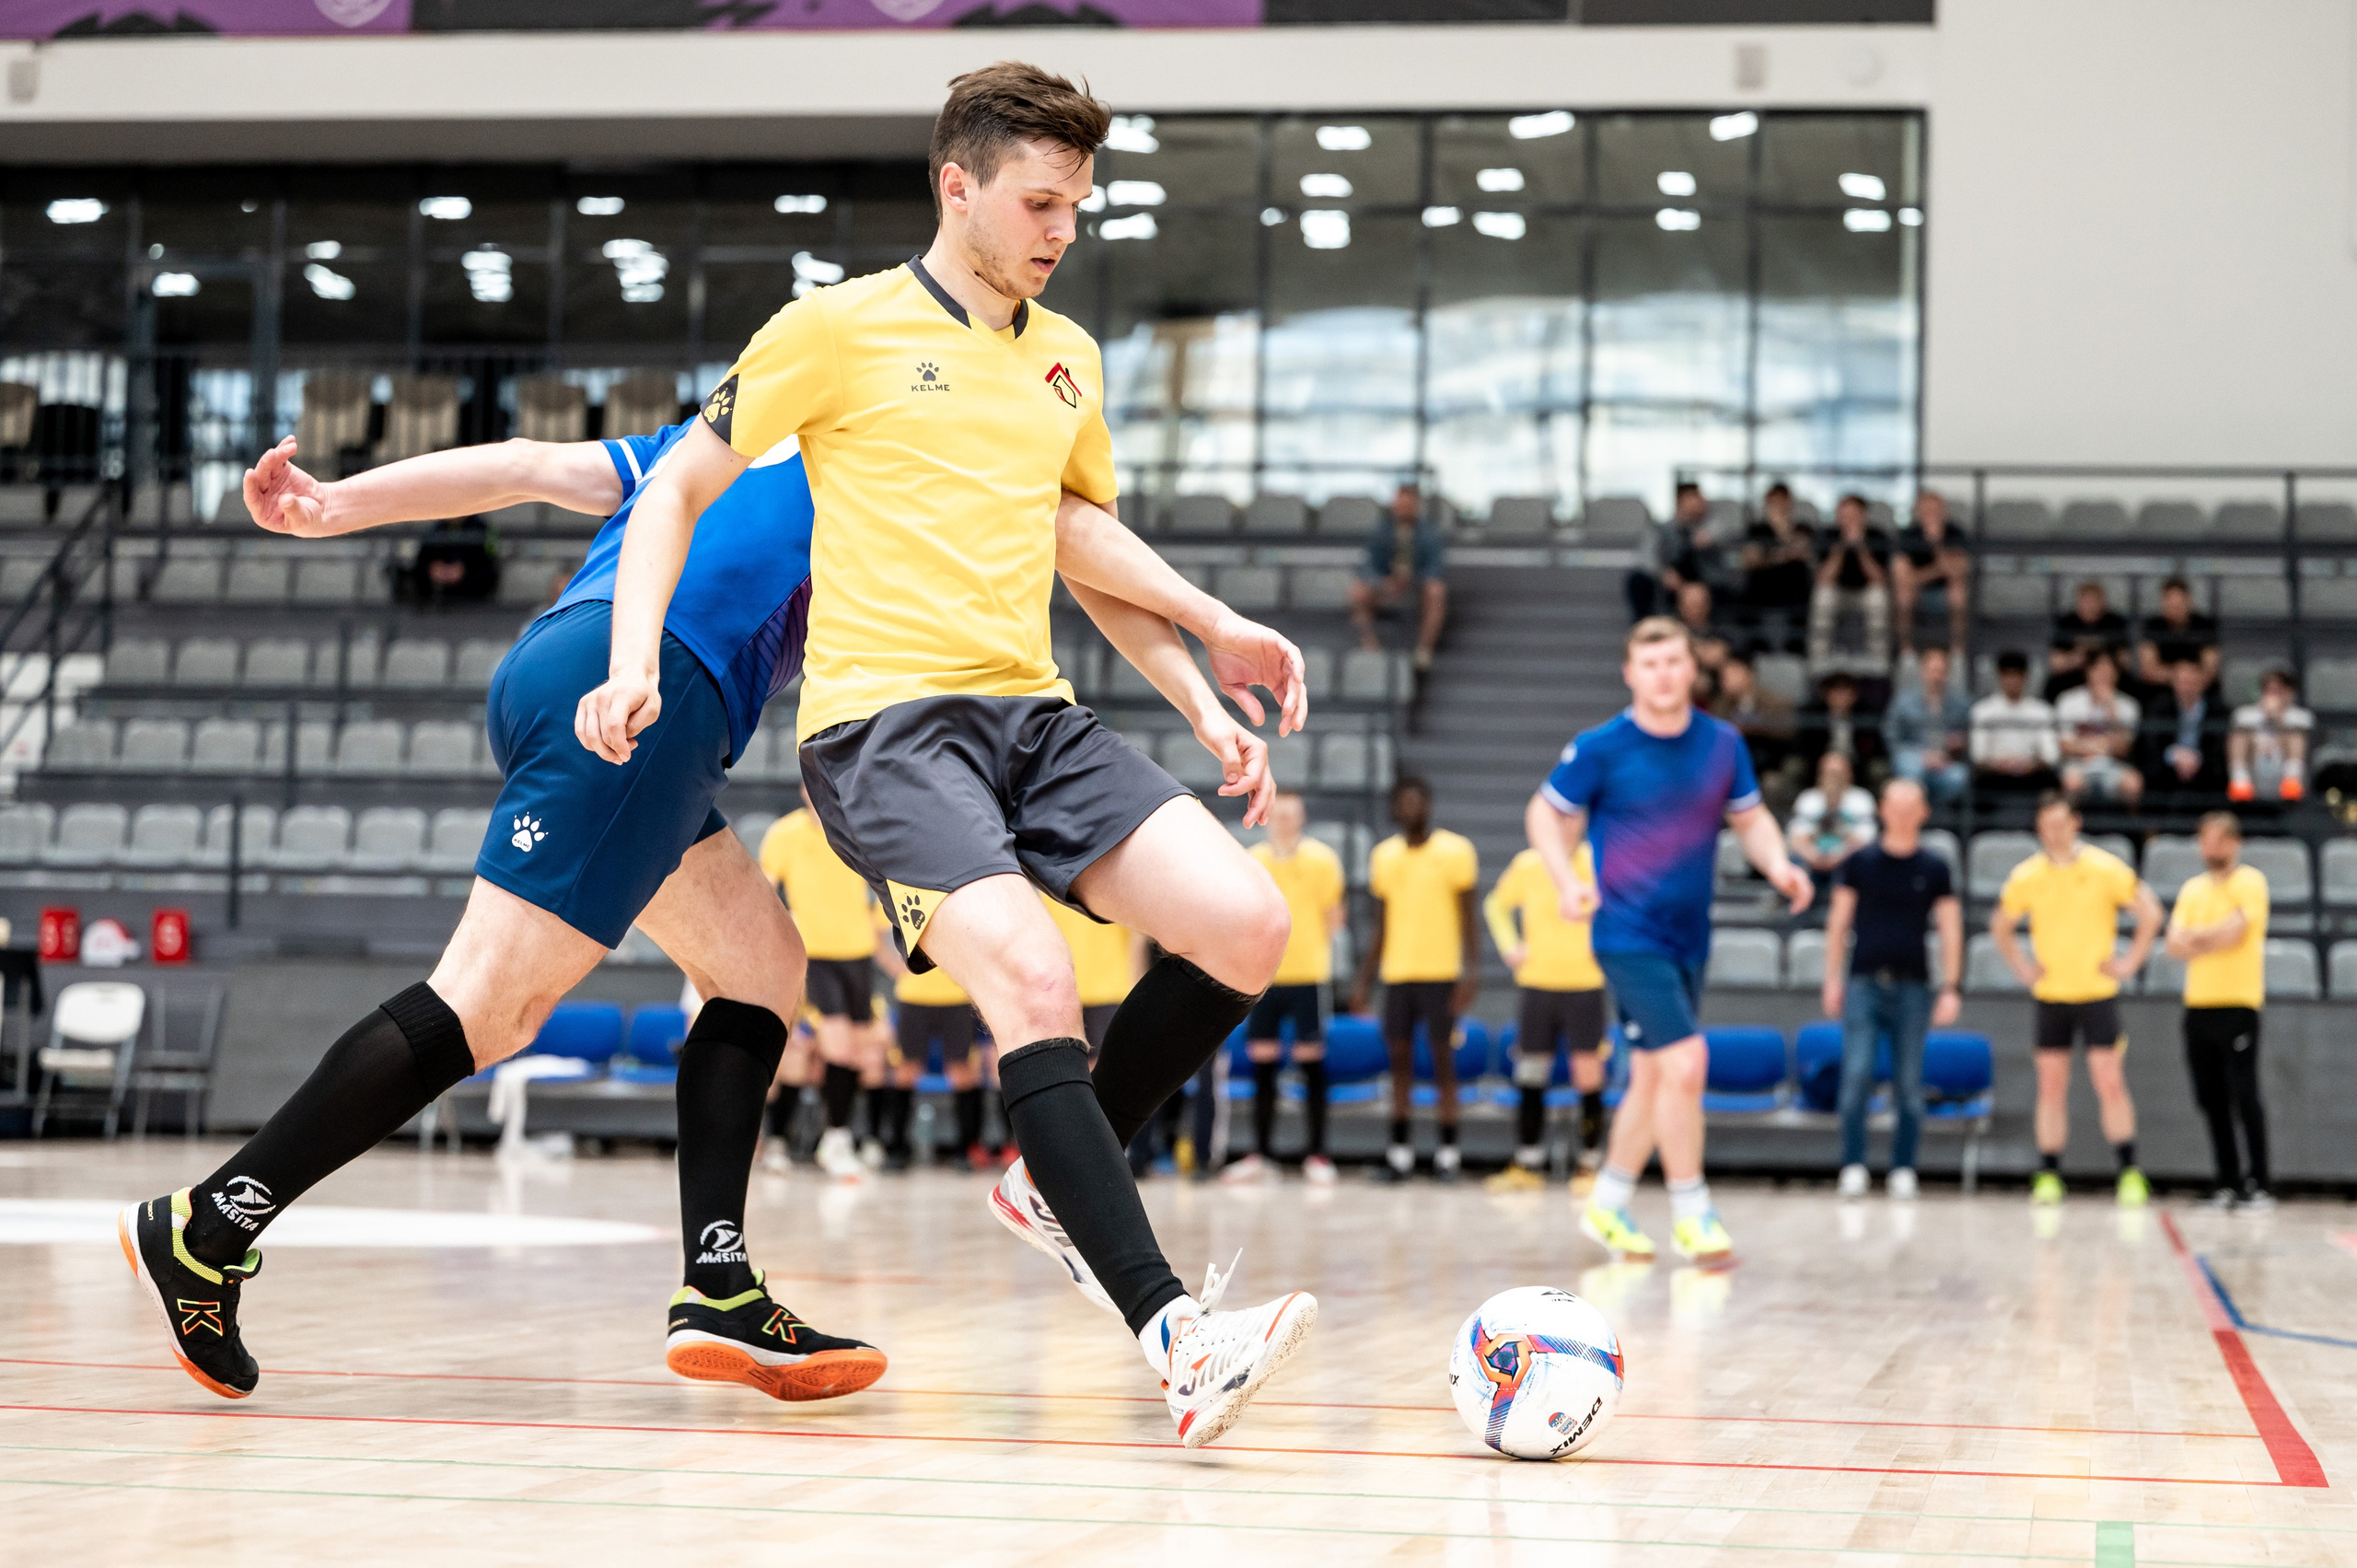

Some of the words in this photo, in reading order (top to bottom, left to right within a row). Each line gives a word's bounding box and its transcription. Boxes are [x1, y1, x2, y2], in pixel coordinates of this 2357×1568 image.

[211, 1191, 260, 1232] MASITA
[696, 1251, 748, 1264] MASITA
[1550, 1396, 1603, 1456] DEMIX
